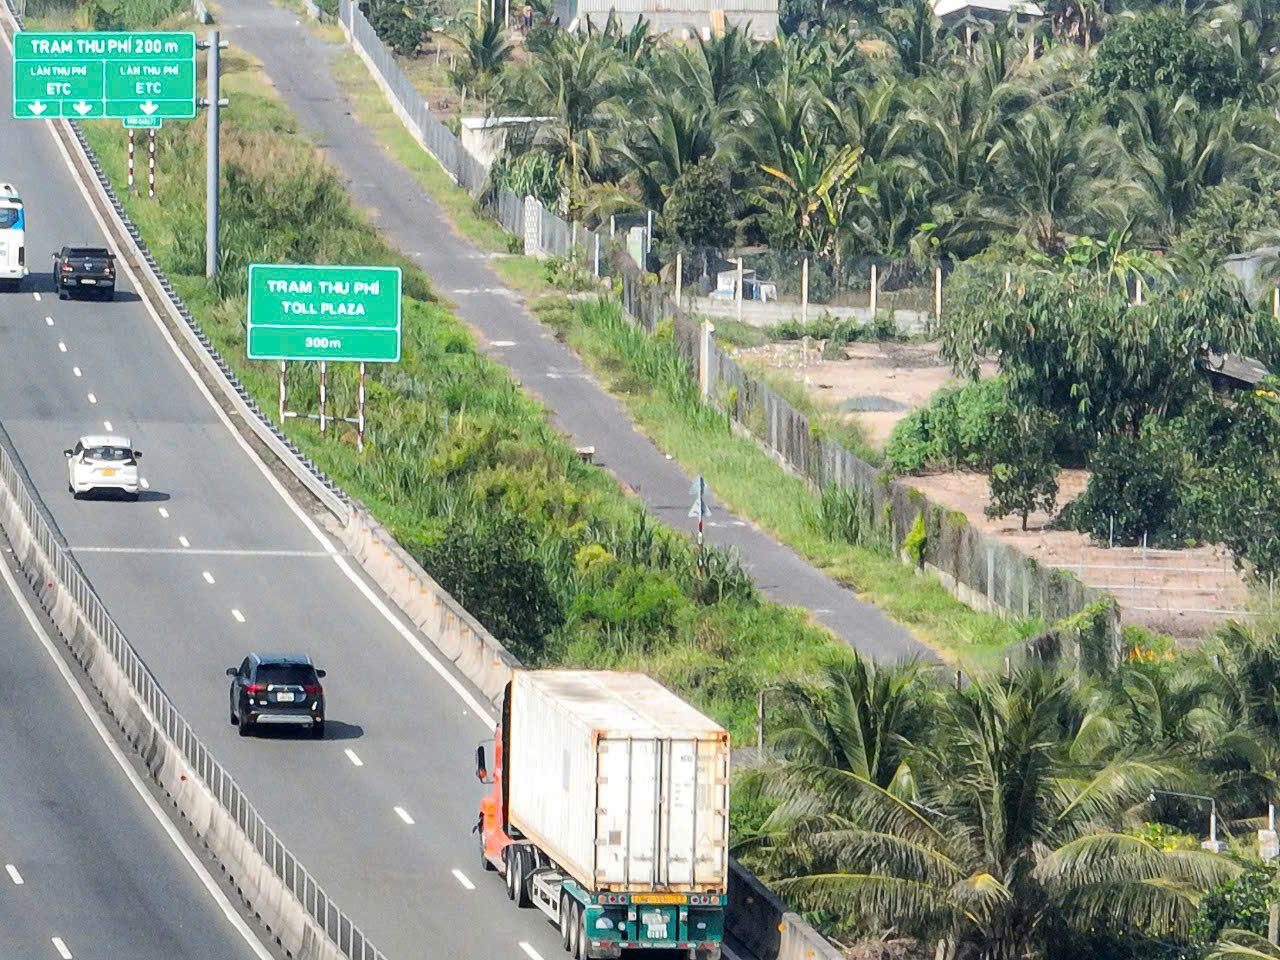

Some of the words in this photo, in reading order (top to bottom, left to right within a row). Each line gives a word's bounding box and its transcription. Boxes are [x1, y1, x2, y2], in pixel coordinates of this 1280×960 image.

[77, 39, 106, 54] THU
[108, 36, 133, 54] PHÍ
[135, 39, 162, 54] 200
[165, 42, 179, 53] m
[52, 66, 70, 76] THU
[72, 65, 87, 76] PHÍ
[143, 66, 161, 76] THU
[164, 64, 179, 76] PHÍ
[47, 82, 72, 96] ETC
[136, 81, 162, 95] ETC
[318, 281, 350, 295] THU
[354, 280, 380, 296] PHÍ
[281, 301, 318, 315] TOLL
[321, 302, 365, 316] PLAZA
[305, 337, 342, 349] 300m
